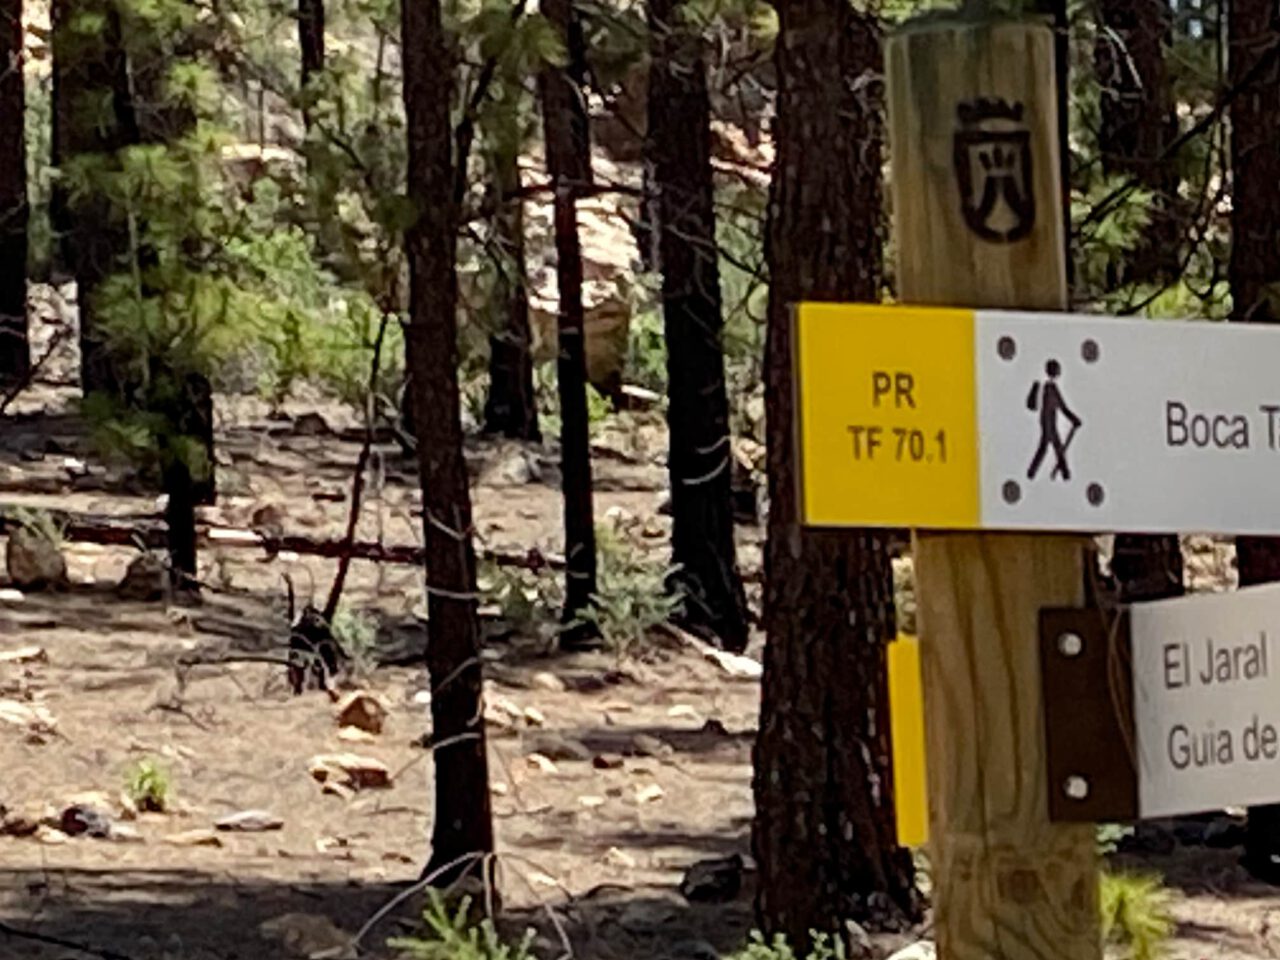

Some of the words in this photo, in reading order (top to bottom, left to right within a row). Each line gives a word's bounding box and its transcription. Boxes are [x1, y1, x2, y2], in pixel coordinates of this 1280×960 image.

[872, 371, 916, 409] PR
[846, 425, 883, 461] TF
[892, 427, 947, 464] 70.1
[1166, 400, 1250, 450] Boca
[1163, 642, 1190, 690] El
[1199, 631, 1268, 685] Jaral
[1242, 713, 1278, 761] de
